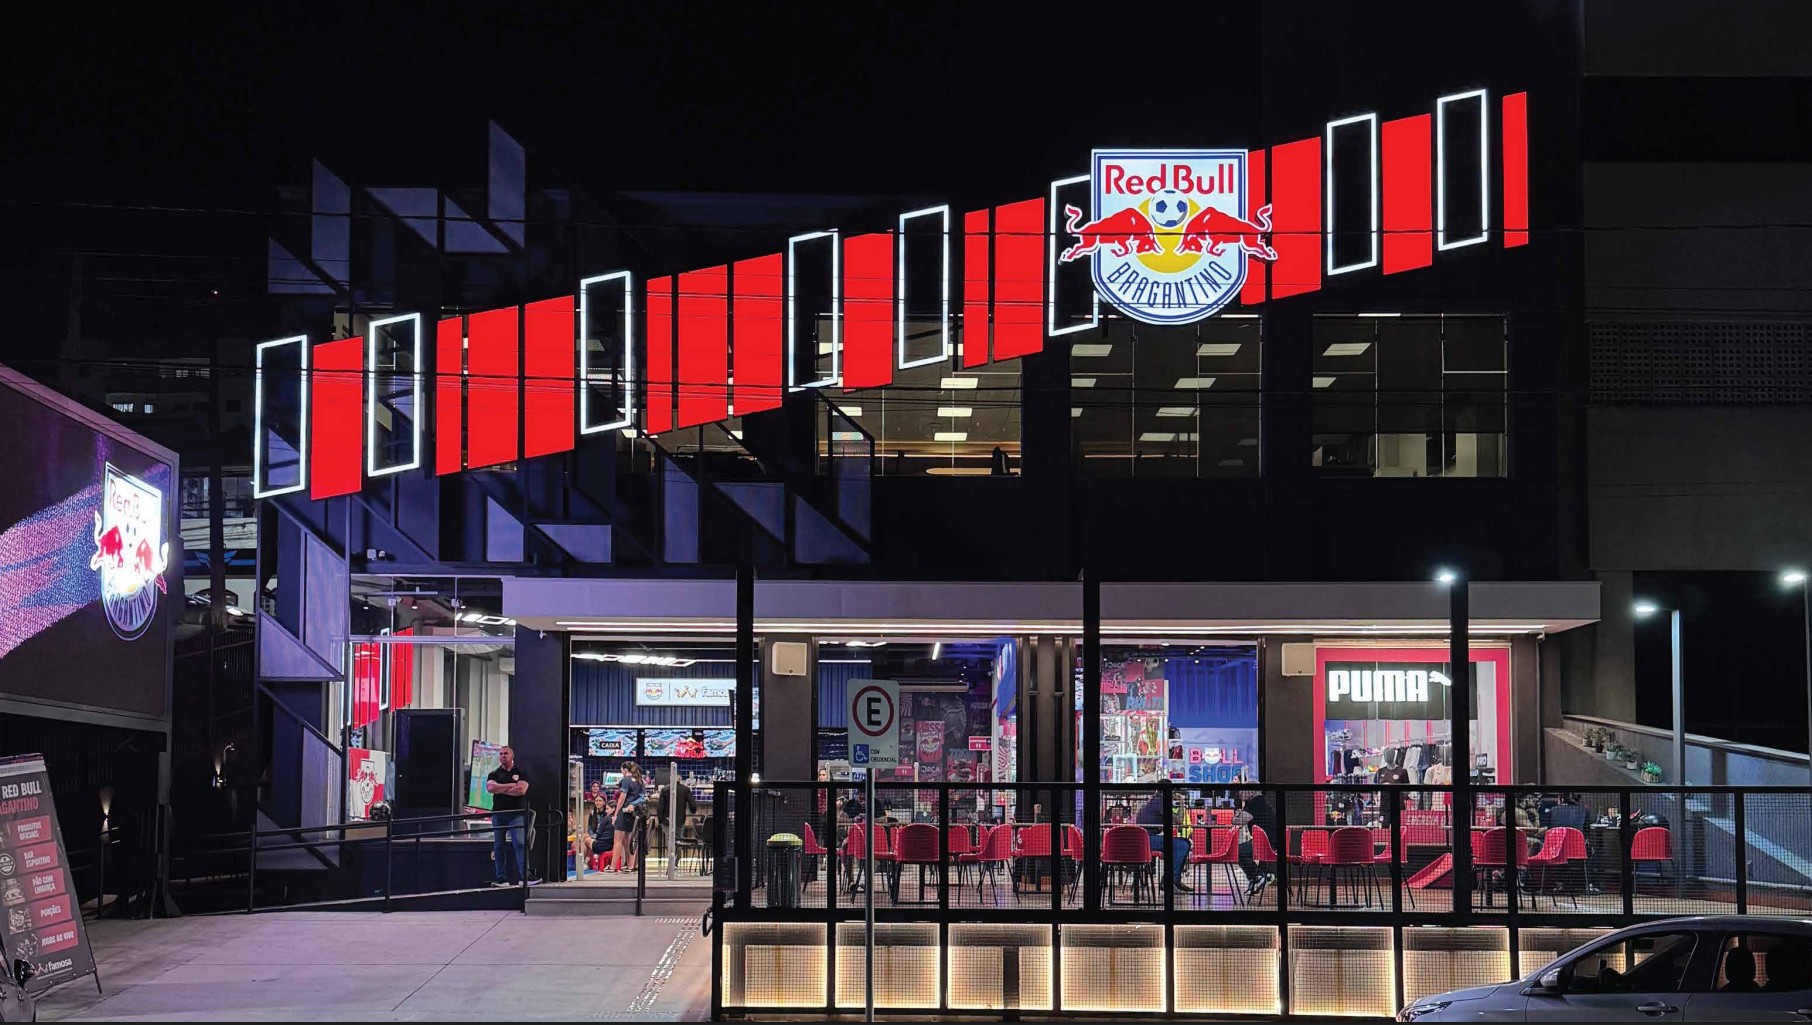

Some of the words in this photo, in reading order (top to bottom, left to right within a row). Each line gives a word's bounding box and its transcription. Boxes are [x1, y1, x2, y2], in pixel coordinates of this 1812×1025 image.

[1105, 164, 1167, 194] Red
[1173, 164, 1233, 194] Bull
[1107, 261, 1232, 308] BRAGANTINO
[1328, 670, 1429, 702] PUMA
[867, 697, 882, 726] E
[2, 784, 19, 799] RED
[21, 781, 42, 796] BULL
[48, 959, 72, 971] famosa
